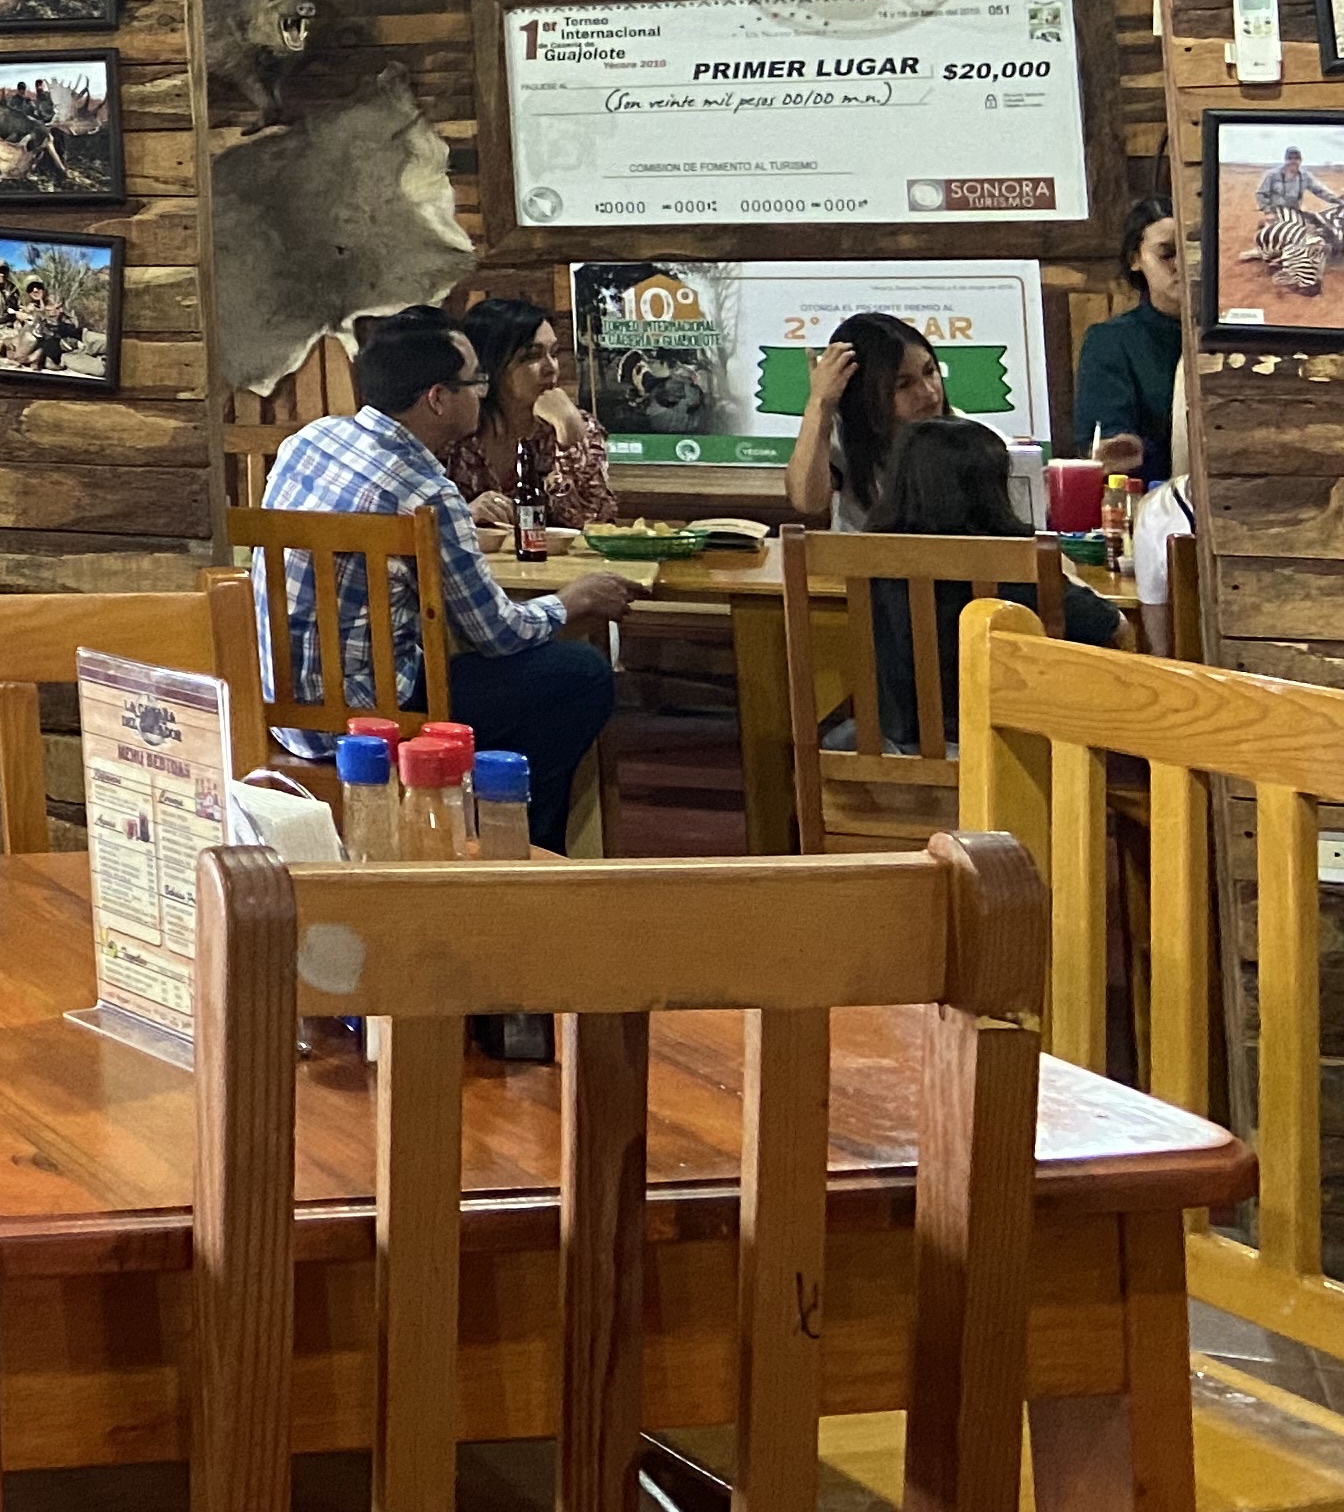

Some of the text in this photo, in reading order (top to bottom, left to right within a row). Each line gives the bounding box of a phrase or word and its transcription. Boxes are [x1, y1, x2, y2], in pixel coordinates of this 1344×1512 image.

[988, 4, 1010, 16] 051
[563, 16, 609, 27] Torneo
[561, 25, 662, 40] Internacional
[544, 47, 626, 63] Guajolote
[692, 57, 920, 80] PRIMER LUGAR
[942, 60, 1051, 83] $20,000
[648, 94, 695, 109] veinte
[702, 93, 733, 108] mil
[733, 94, 774, 114] pesos
[629, 160, 818, 173] COMISION DE FOMENTO AL TURISMO
[950, 180, 1050, 198] SONORA
[967, 196, 1035, 209] TURISMO
[842, 304, 854, 312] EL
[943, 304, 954, 312] AL
[784, 316, 820, 340] 2°
